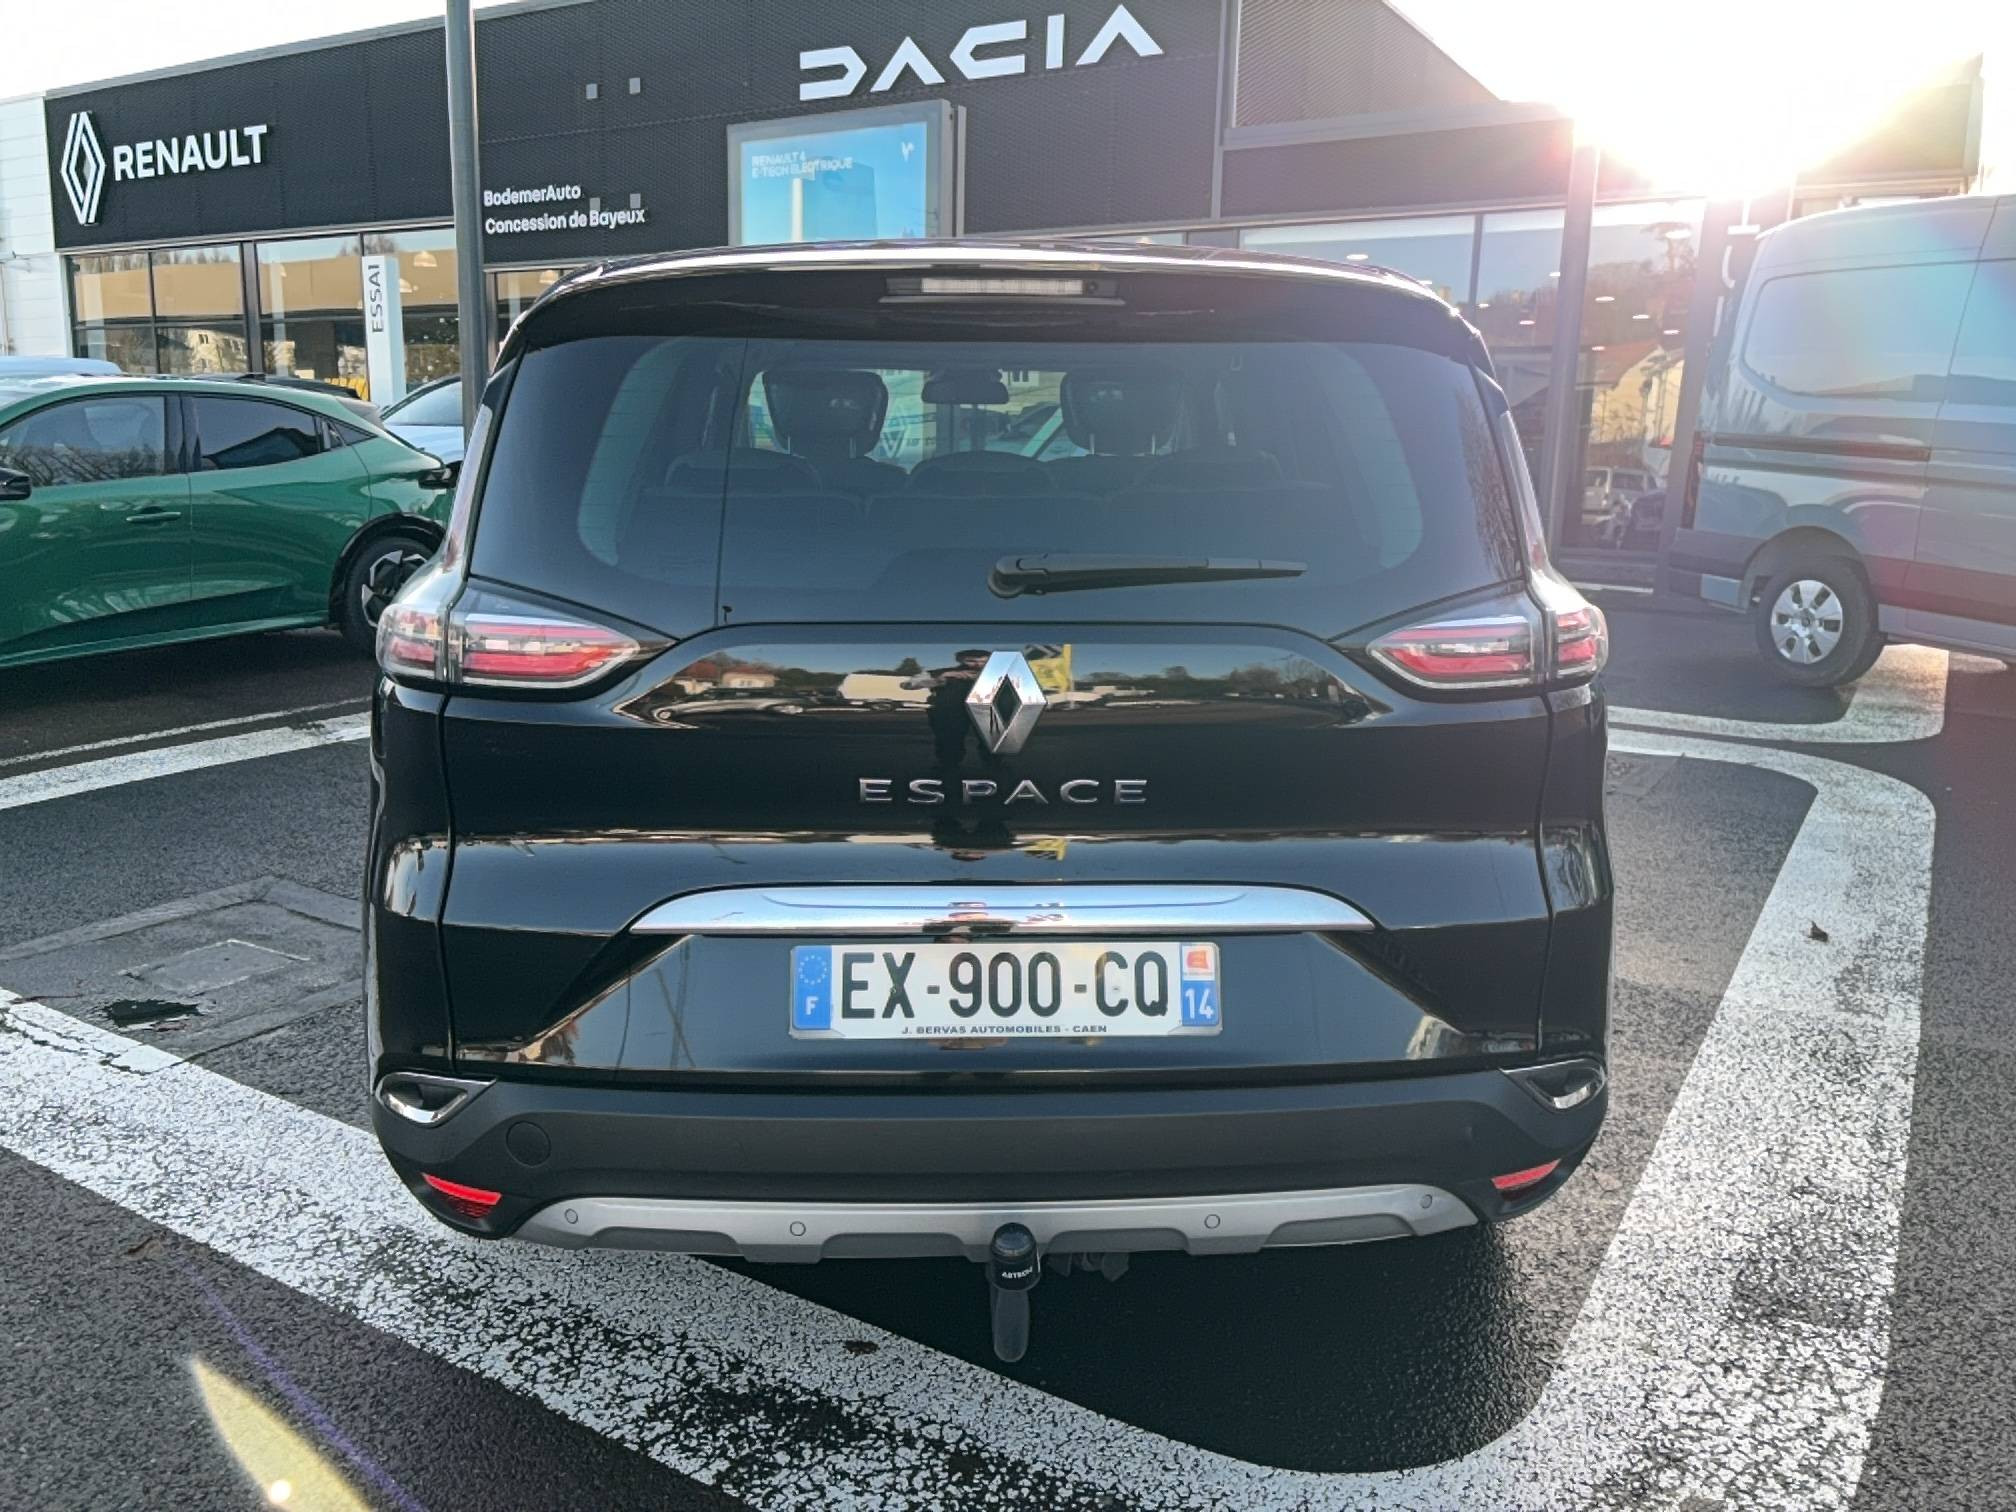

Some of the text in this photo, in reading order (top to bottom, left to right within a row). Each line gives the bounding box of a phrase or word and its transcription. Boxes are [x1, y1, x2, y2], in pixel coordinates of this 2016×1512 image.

[799, 4, 1164, 101] DACIA
[113, 124, 268, 182] RENAULT
[751, 152, 799, 167] RENAULT
[483, 184, 582, 207] BodemerAuto
[485, 208, 646, 234] Concession de Bayeux
[368, 264, 384, 333] ESSAI
[858, 777, 1148, 805] ESPACE
[841, 950, 1169, 1020] EX-900-CQ
[805, 996, 819, 1016] F
[1185, 987, 1214, 1020] 14
[902, 1026, 913, 1035] J.
[916, 1026, 967, 1035] BERVAS
[970, 1025, 1061, 1035] AUTOMOBILES
[1072, 1025, 1108, 1034] CAEN
